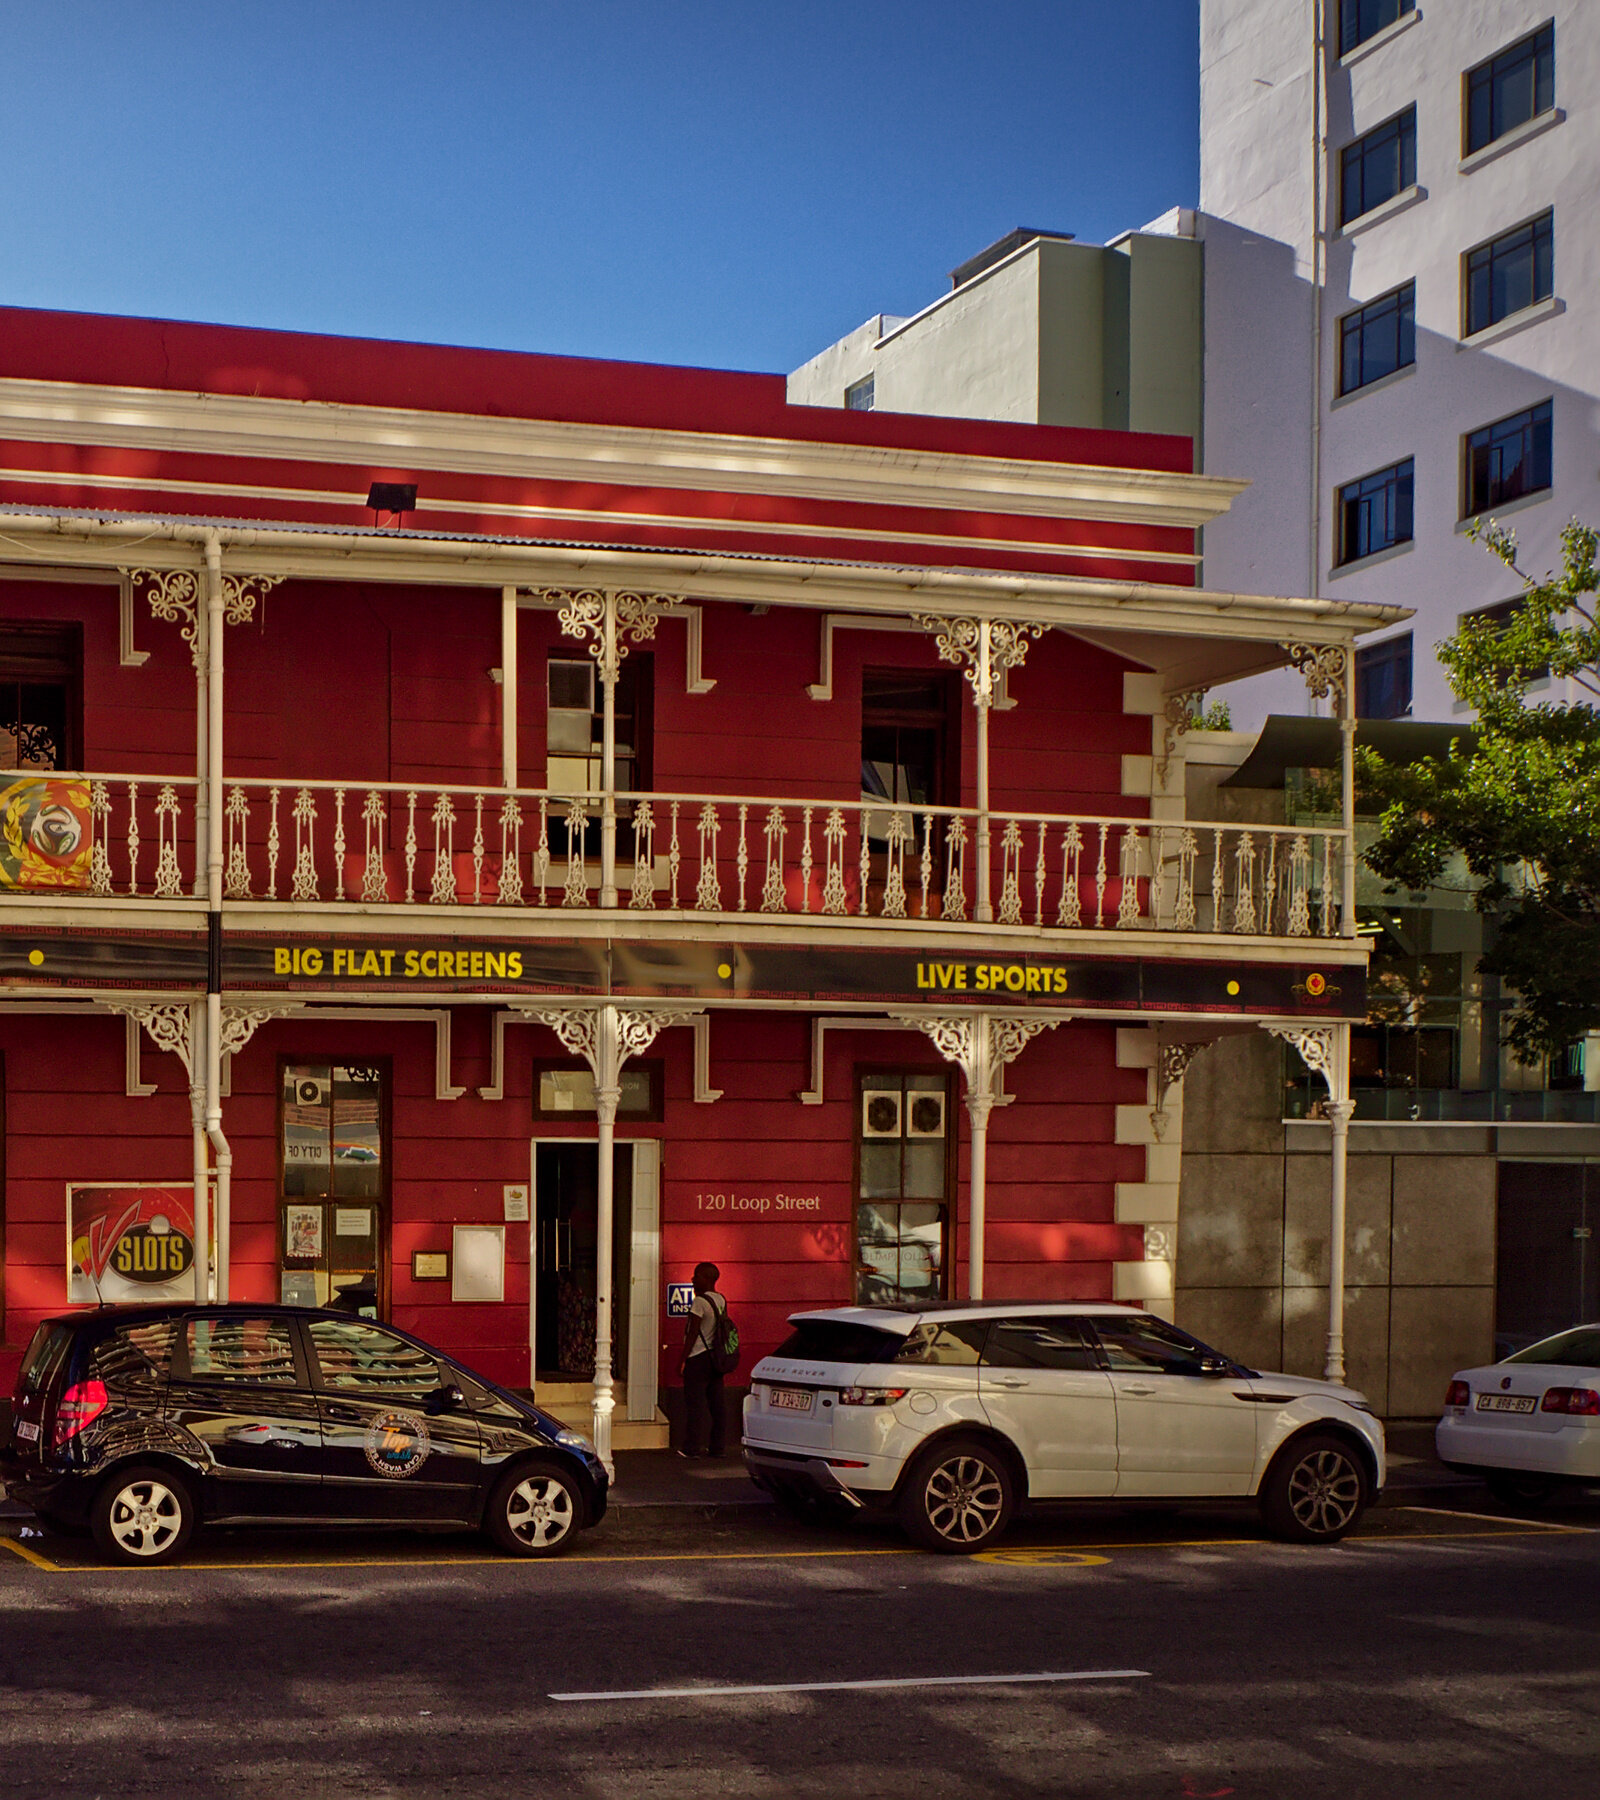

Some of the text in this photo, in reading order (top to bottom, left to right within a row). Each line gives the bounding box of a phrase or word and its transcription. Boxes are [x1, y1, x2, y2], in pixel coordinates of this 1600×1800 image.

[274, 948, 523, 978] BIG FLAT SCREENS
[917, 963, 1068, 993] LIVE SPORTS
[697, 1194, 820, 1213] 120 Loop Street
[118, 1236, 183, 1271] SLOTS
[382, 1427, 413, 1453] Top
[378, 1459, 402, 1471] WASH
[405, 1455, 419, 1469] CAR
